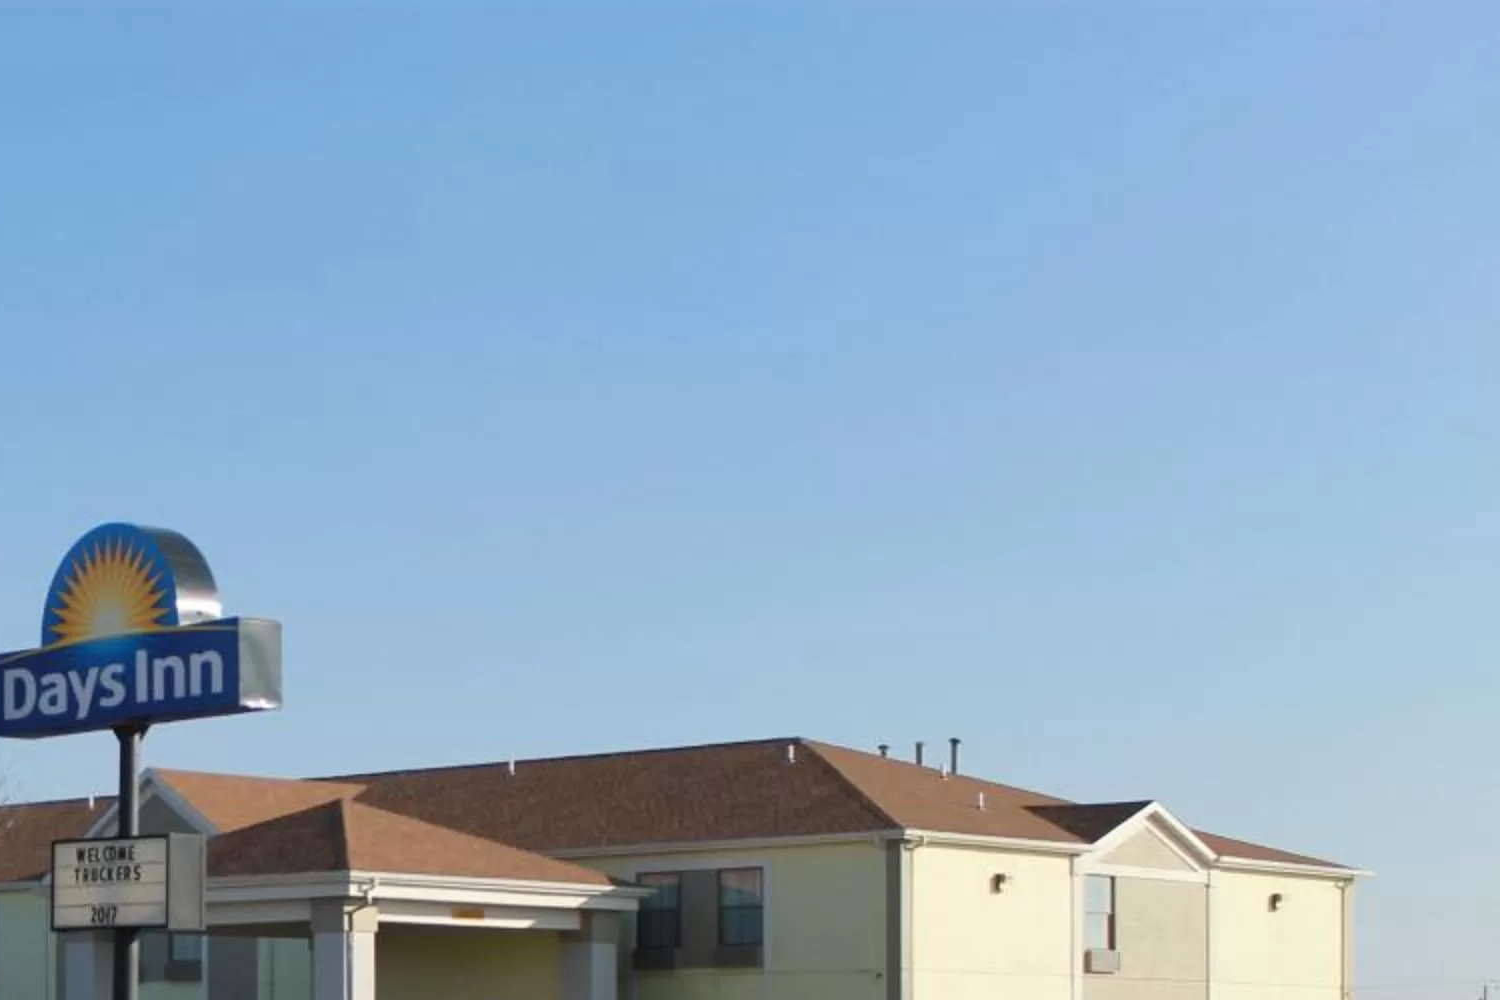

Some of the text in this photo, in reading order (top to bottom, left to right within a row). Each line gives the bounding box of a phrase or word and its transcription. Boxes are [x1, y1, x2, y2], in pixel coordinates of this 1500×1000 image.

[2, 649, 224, 721] Days Inn
[75, 845, 135, 864] WELCOME
[74, 864, 142, 883] TRUCKERS
